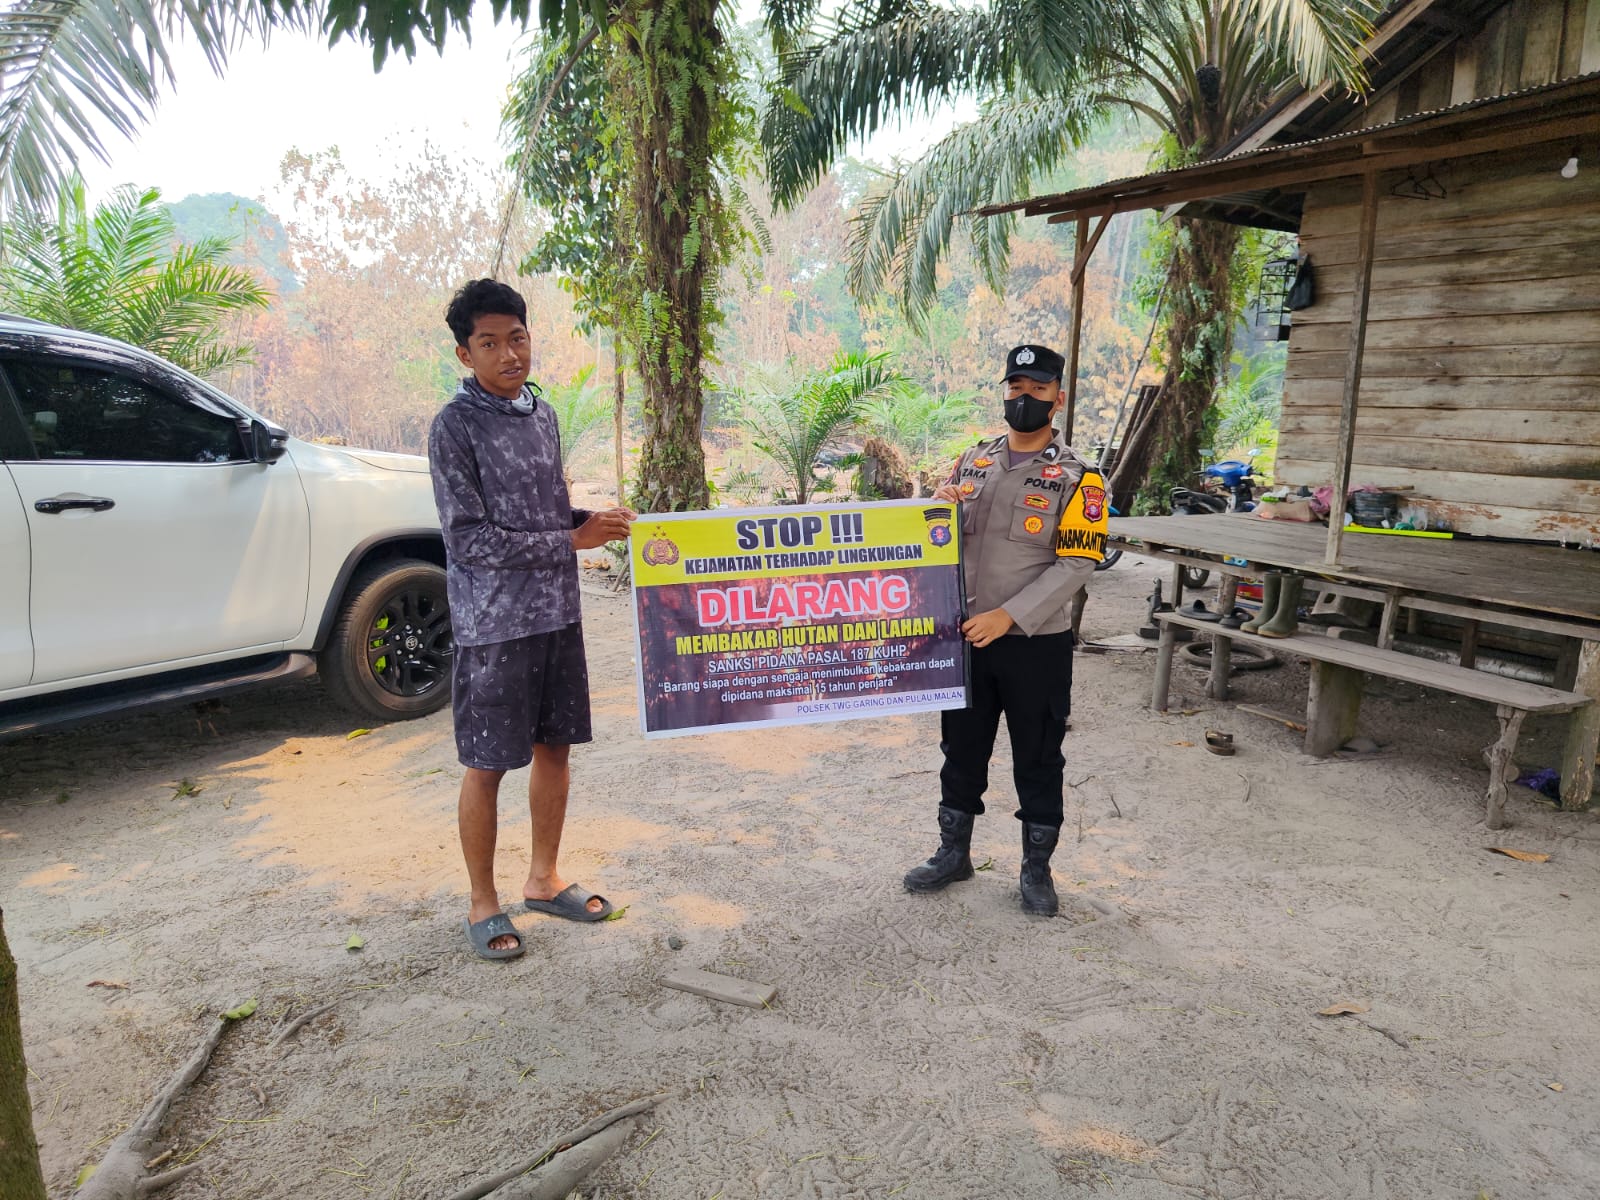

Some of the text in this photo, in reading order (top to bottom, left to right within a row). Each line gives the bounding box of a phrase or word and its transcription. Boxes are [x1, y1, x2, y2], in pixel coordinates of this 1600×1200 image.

[962, 468, 987, 479] ZAKA
[1024, 477, 1062, 492] POLRI
[737, 513, 863, 550] STOP !!!
[685, 544, 922, 575] KEJAHATAN TERHADAP LINGKUNGAN
[698, 575, 910, 626] DILARANG
[676, 617, 935, 655] MEMBAKAR HUTAN DAN LAHAN
[702, 679, 729, 690] siapa
[732, 675, 768, 688] dengan
[771, 669, 809, 683] sengaja
[812, 664, 877, 680] menimbulkan
[878, 660, 926, 674] kebakaran
[928, 657, 955, 672] dapat
[708, 645, 907, 673] SANKSI PIDANA PASAL 187 KUHP
[721, 689, 763, 704] dipidana
[766, 682, 812, 698] maksimal
[815, 682, 826, 693] 15
[829, 679, 856, 691] tahun
[797, 703, 830, 714] POLSEK
[853, 698, 884, 709] GARING
[887, 696, 904, 706] DAN
[905, 694, 932, 705] PULAU
[934, 691, 963, 702] MALAN
